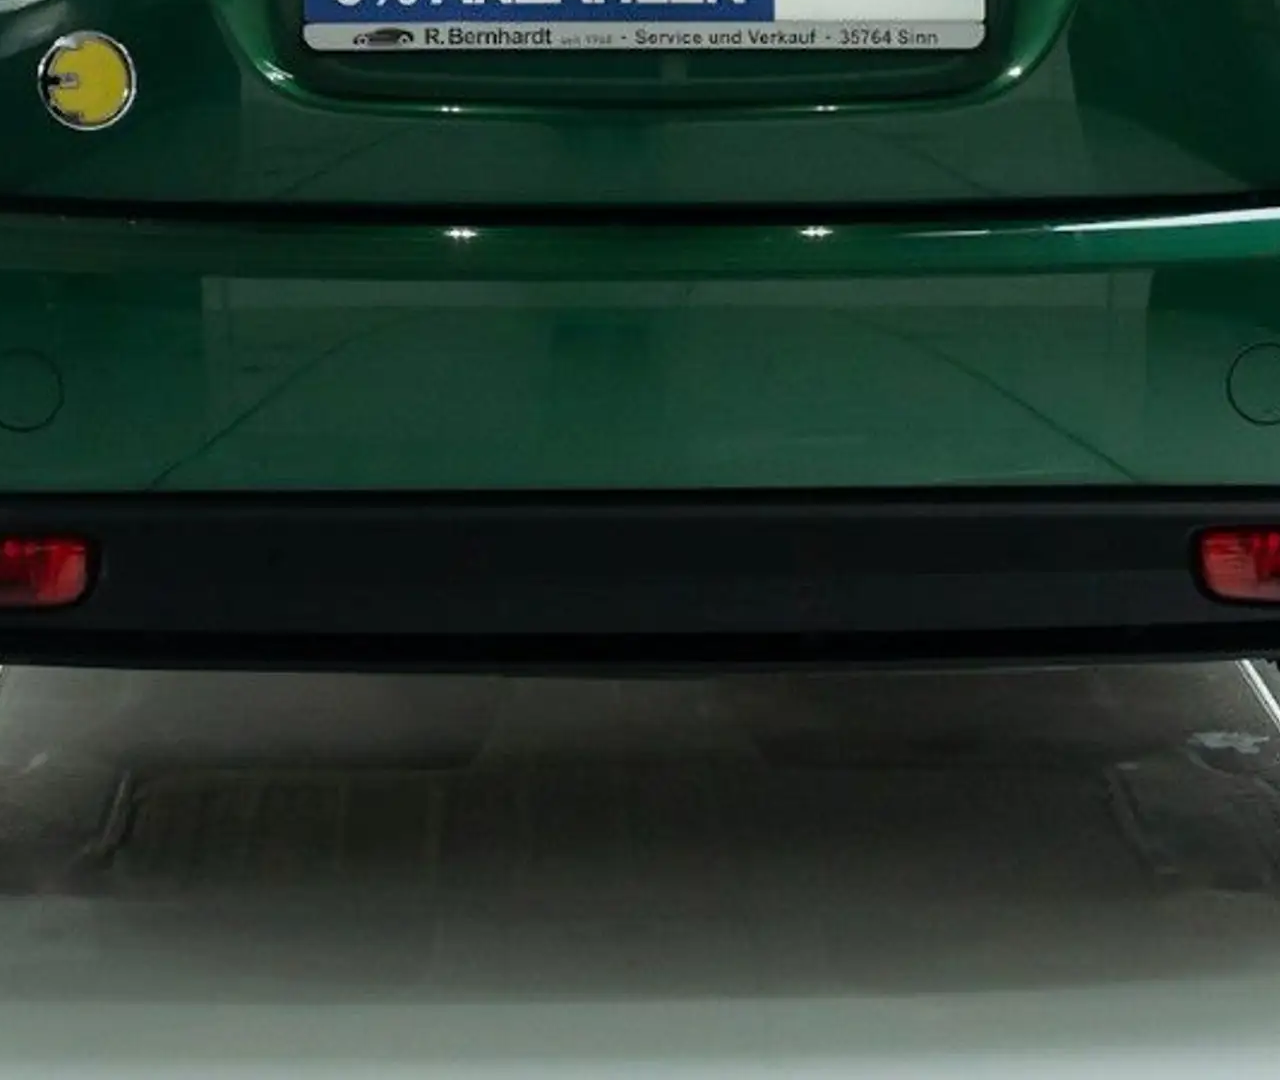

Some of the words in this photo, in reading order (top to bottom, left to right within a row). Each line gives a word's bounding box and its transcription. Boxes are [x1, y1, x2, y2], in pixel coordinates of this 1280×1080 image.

[425, 28, 445, 45] R.
[448, 27, 552, 45] Bernhardt
[635, 29, 702, 45] Service
[709, 29, 742, 45] und
[748, 29, 816, 45] Verkauf
[839, 29, 893, 45] 35764
[897, 29, 939, 45] Sinn
